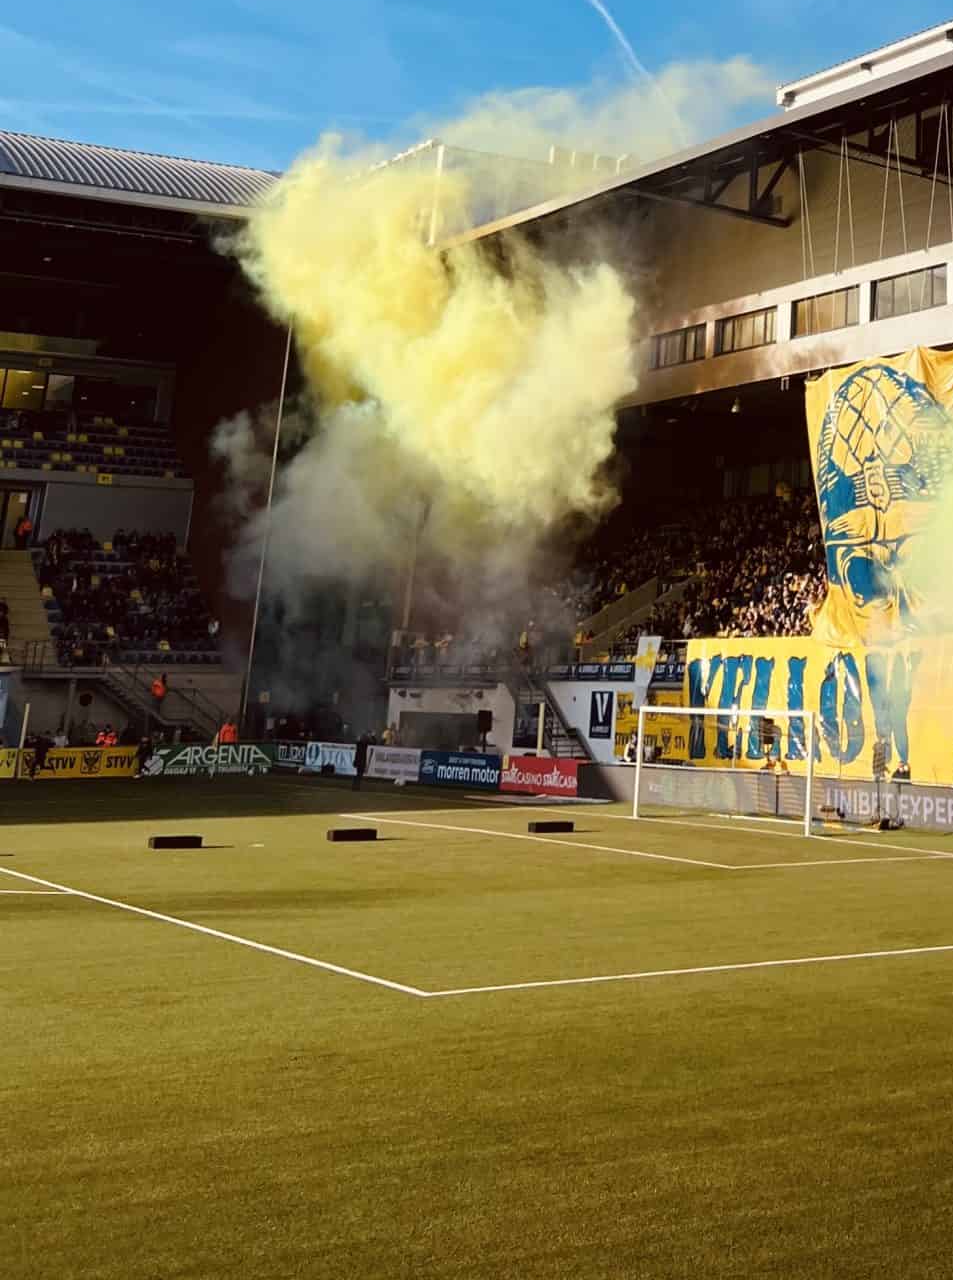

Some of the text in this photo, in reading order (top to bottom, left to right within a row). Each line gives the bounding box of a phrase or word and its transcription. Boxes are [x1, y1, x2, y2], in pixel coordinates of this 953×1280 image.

[595, 693, 609, 723] V
[106, 756, 134, 768] STVV
[166, 745, 272, 766] ARGENTA
[437, 764, 470, 780] morren
[826, 786, 894, 821] UNIBET
